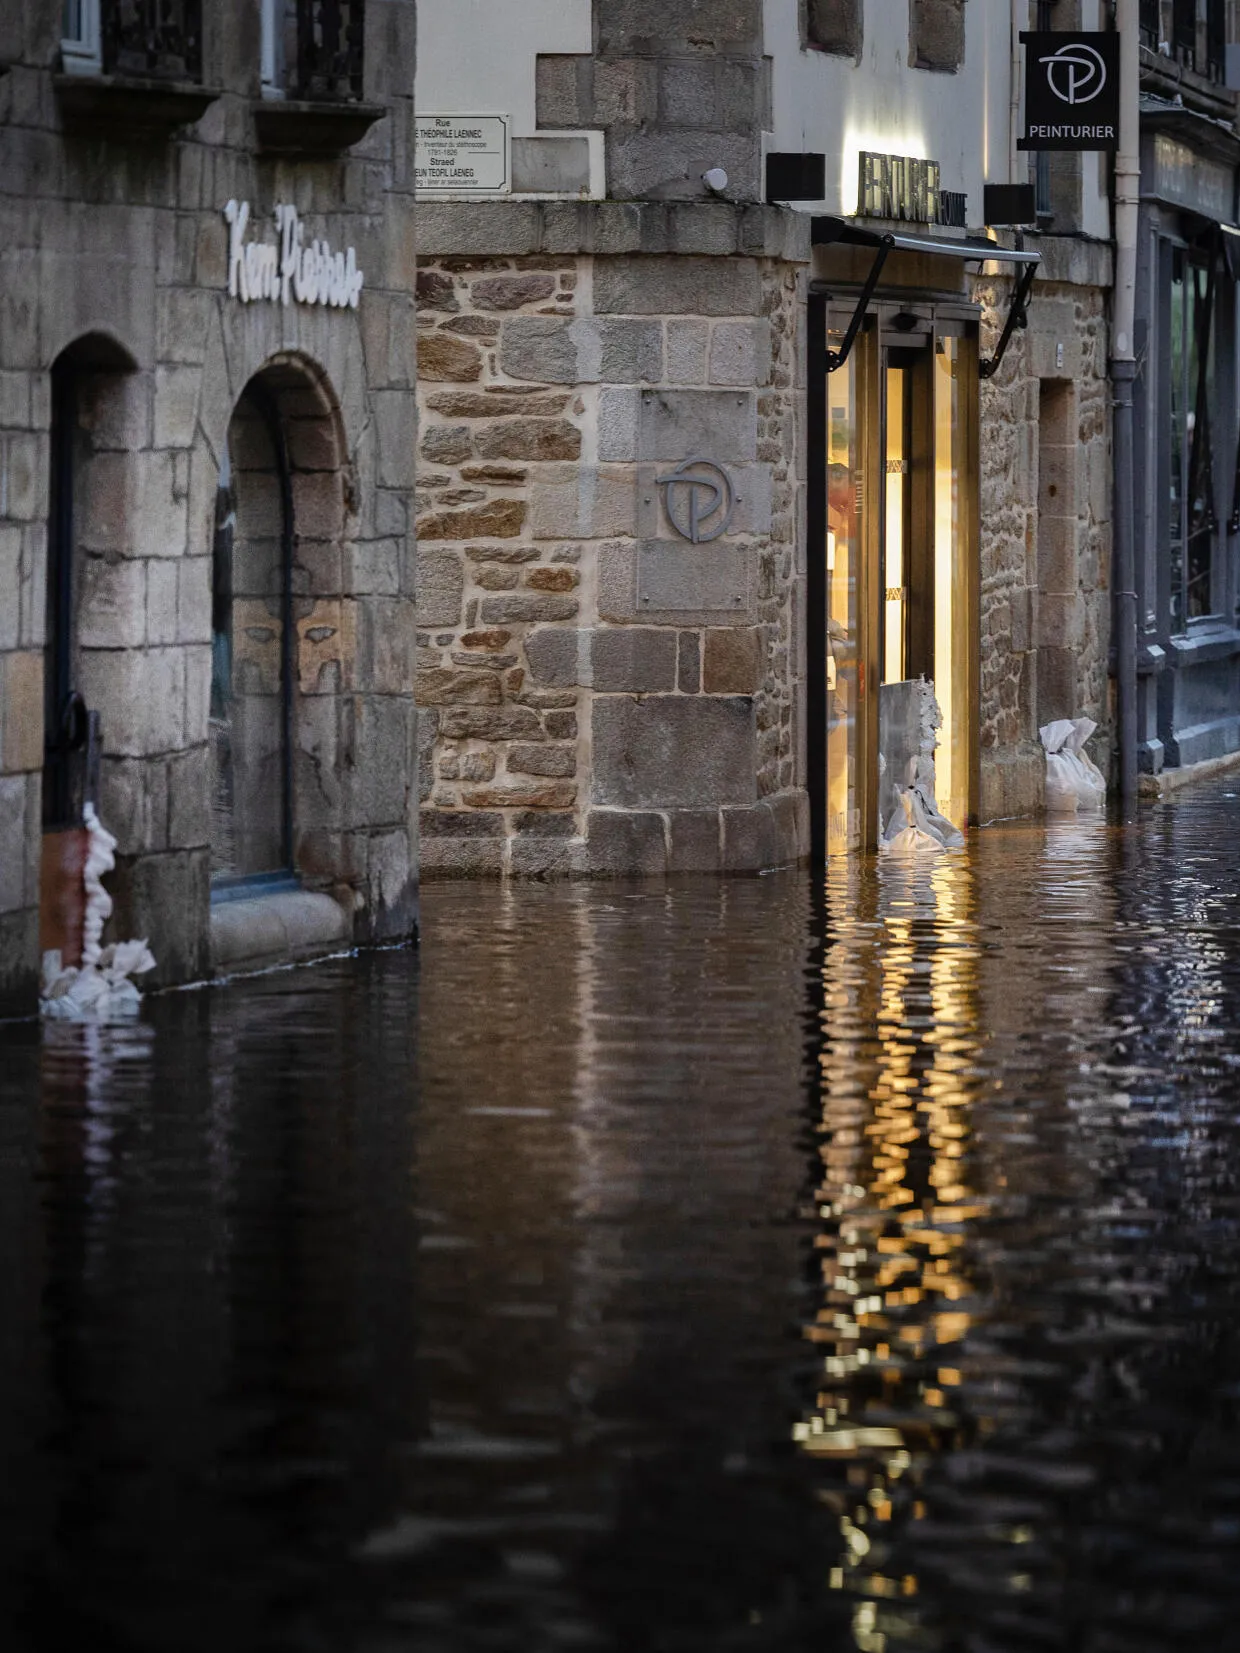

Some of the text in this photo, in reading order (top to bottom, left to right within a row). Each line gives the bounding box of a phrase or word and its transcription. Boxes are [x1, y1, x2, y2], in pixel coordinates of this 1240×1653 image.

[435, 118, 451, 127] Rue
[420, 127, 453, 138] THÉOPHILE
[454, 128, 482, 138] LAENNEC
[1029, 125, 1114, 138] PEINTURIER
[430, 157, 455, 166] Straed
[450, 168, 474, 177] LAENEG
